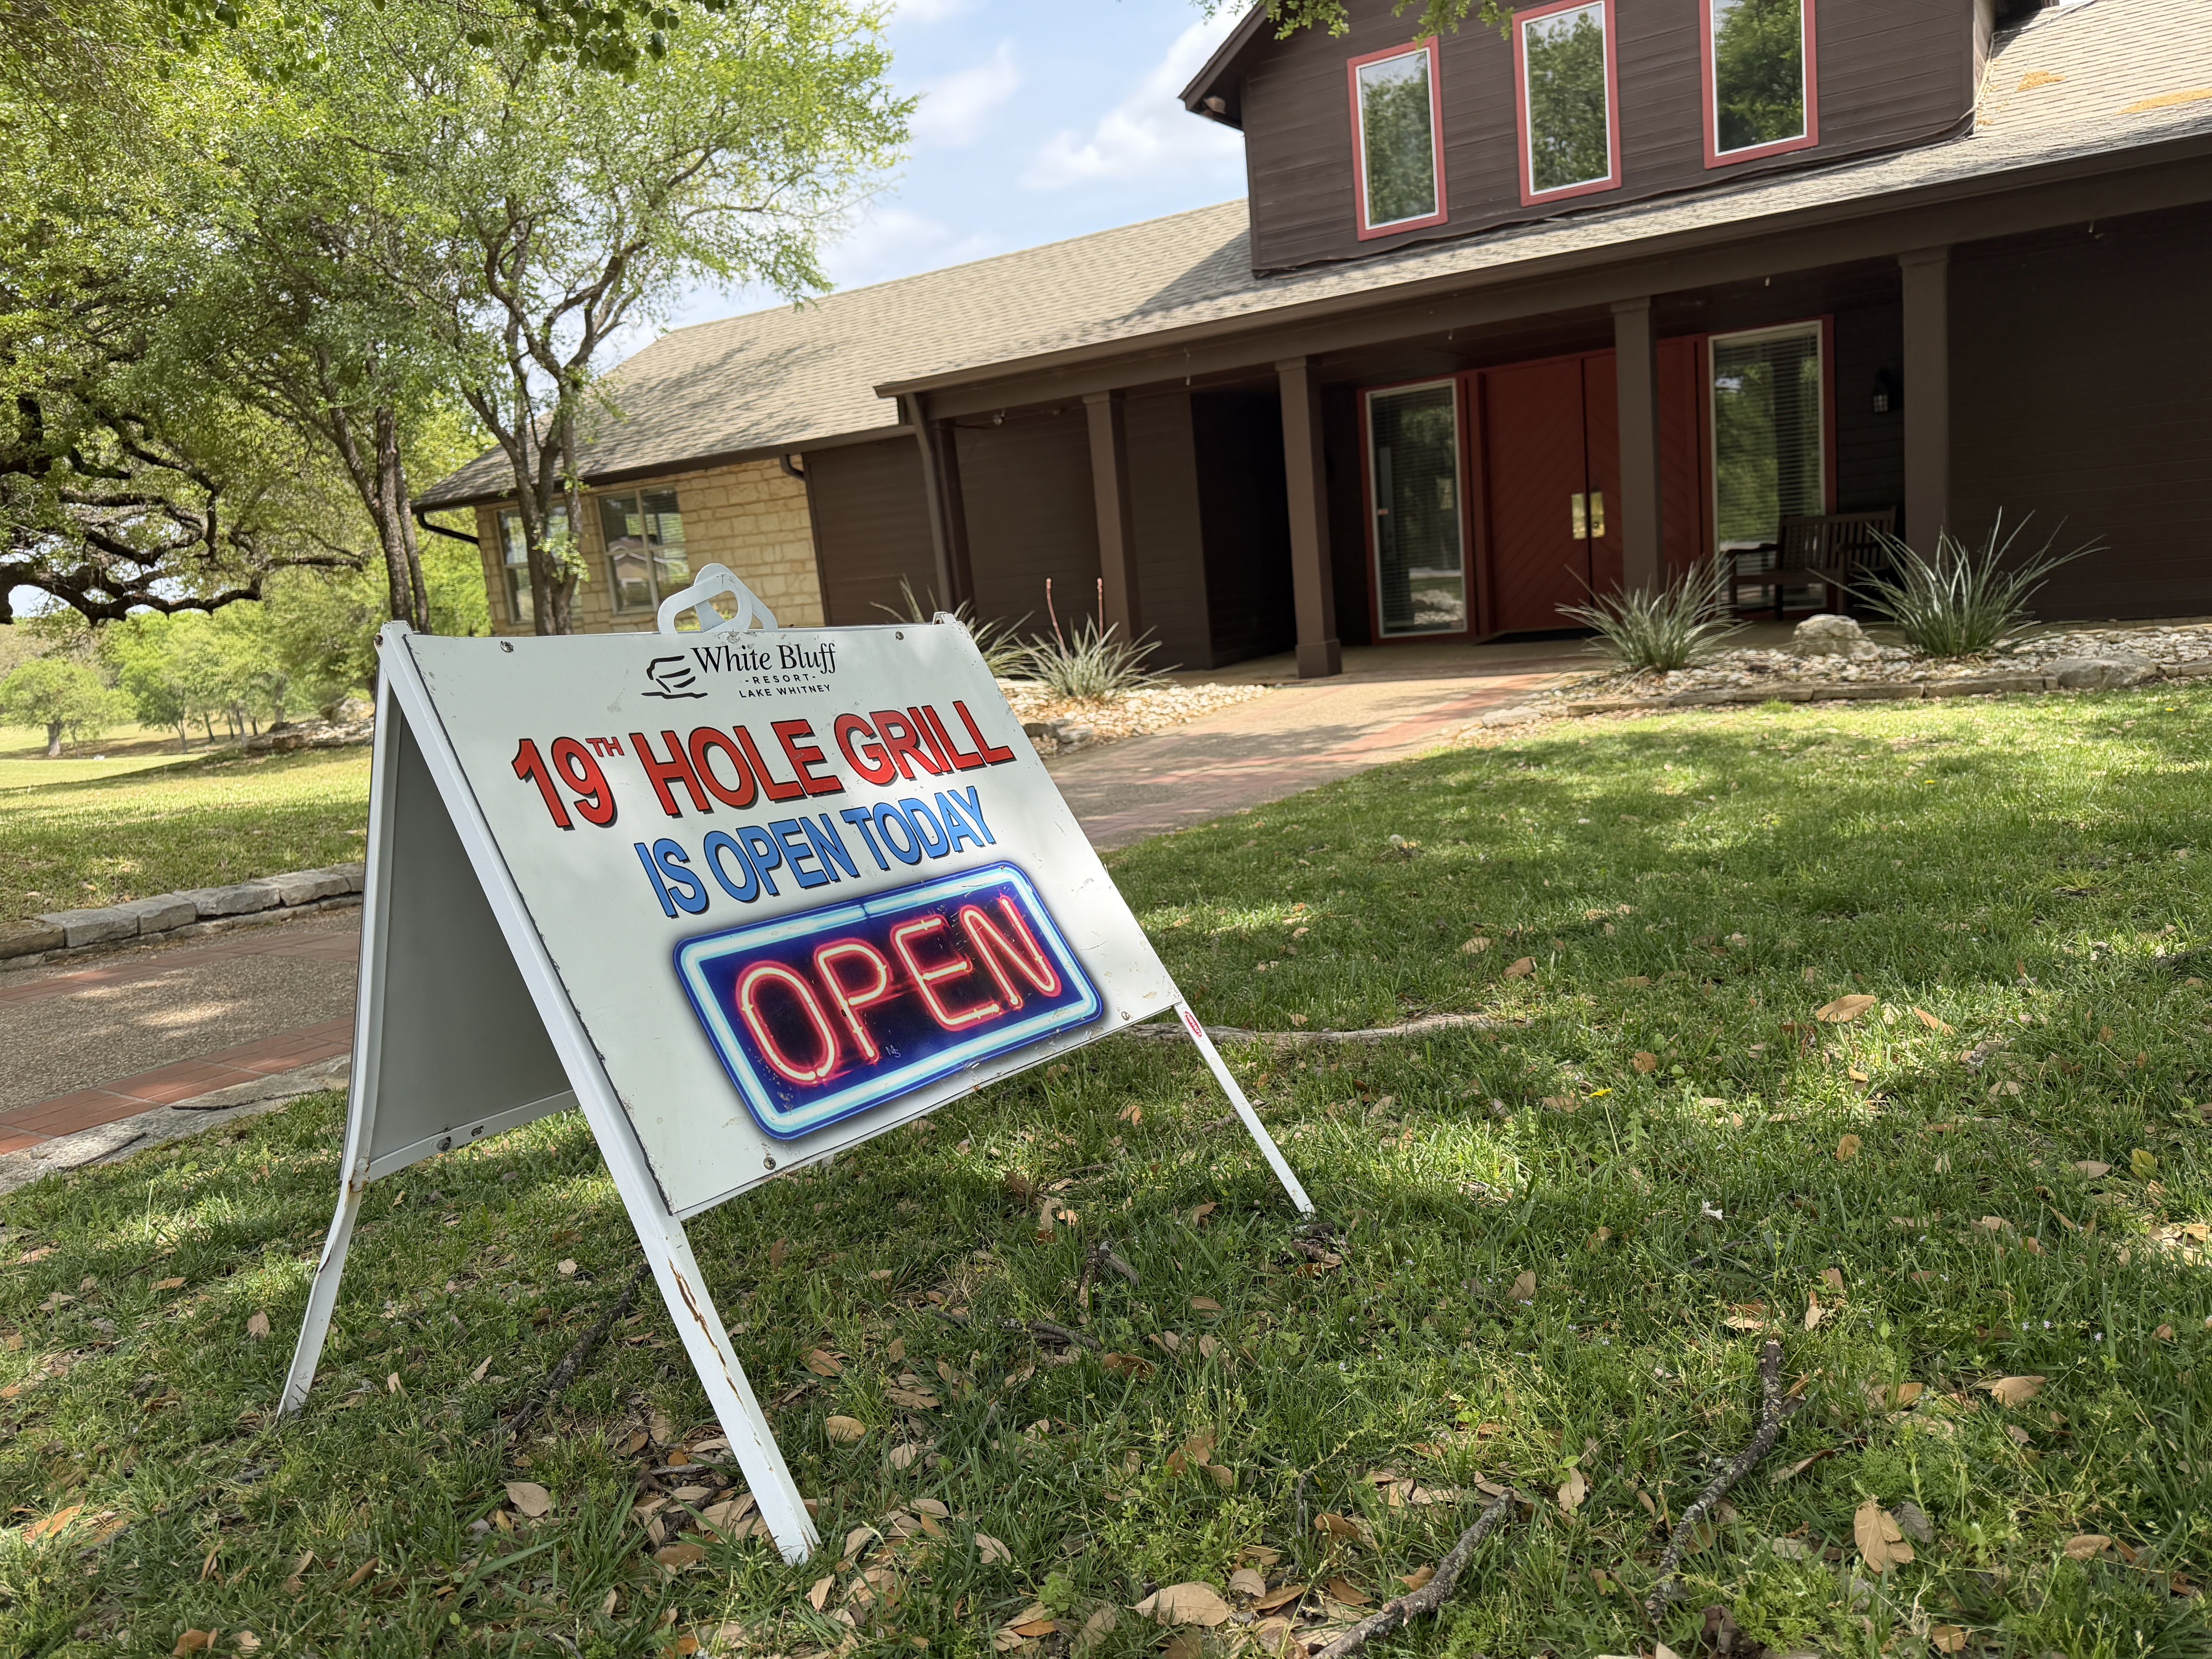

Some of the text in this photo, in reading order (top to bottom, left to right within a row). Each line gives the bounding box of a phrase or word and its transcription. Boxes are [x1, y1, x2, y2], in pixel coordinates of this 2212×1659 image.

[690, 642, 836, 674] White Bluff
[739, 684, 830, 698] LAKE WHITNEY
[628, 719, 844, 818] HOLE
[833, 700, 1017, 786] GRILL
[634, 786, 997, 918] IS OPEN TODAY
[736, 895, 1061, 1084] OPEN
